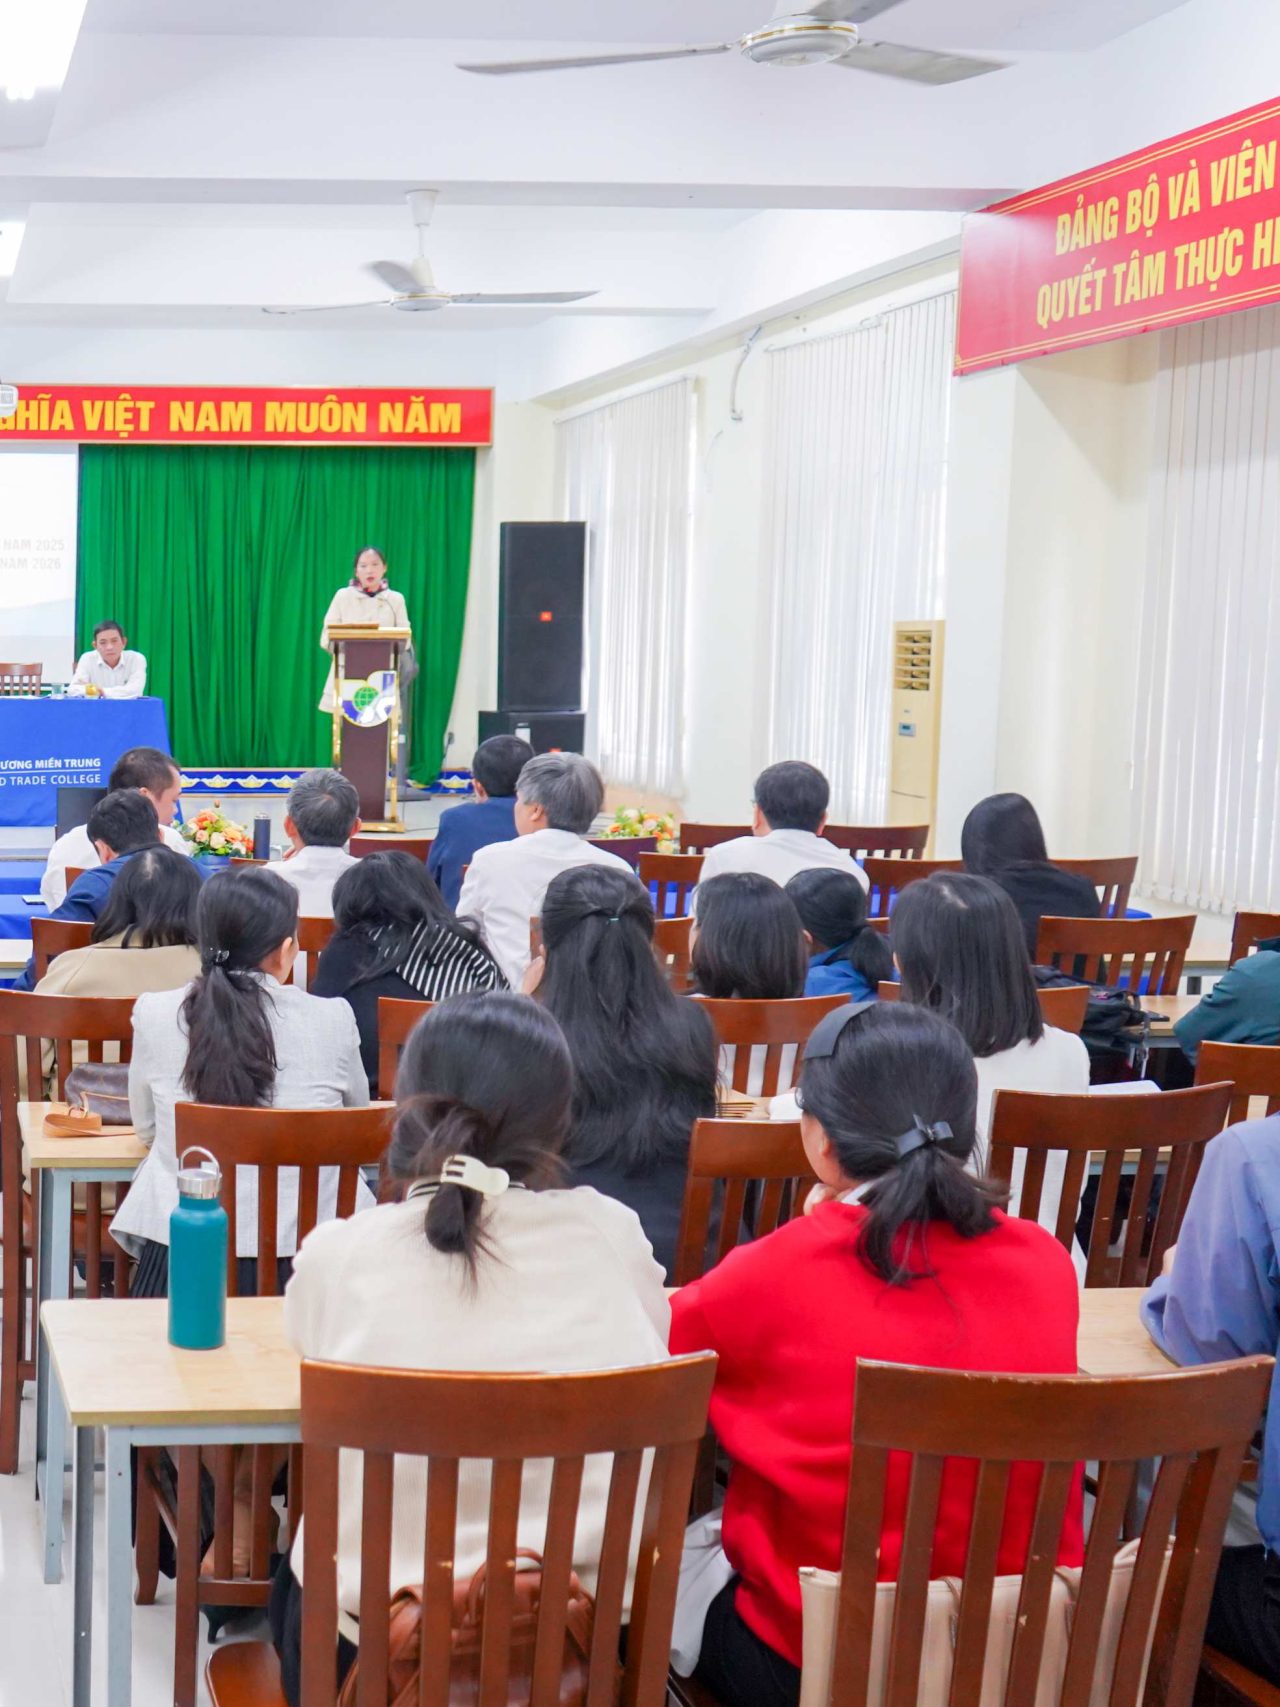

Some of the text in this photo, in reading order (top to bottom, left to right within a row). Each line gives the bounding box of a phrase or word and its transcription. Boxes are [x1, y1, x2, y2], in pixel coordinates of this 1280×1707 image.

[1055, 139, 1277, 257] ĐẢNG BỘ VÀ VIÊN
[1036, 257, 1107, 329] QUYẾT
[1113, 249, 1166, 306] TÂM
[1174, 226, 1244, 292] THỰC
[82, 393, 156, 438] VIỆT
[169, 401, 253, 432] NAM
[265, 394, 367, 433] MUÔN
[378, 395, 461, 433] NĂM
[36, 539, 65, 552] 2025
[32, 557, 62, 570] 2026
[64, 758, 101, 768] TRUNG
[10, 775, 46, 786] TRADE
[50, 774, 101, 785] COLLEGE
